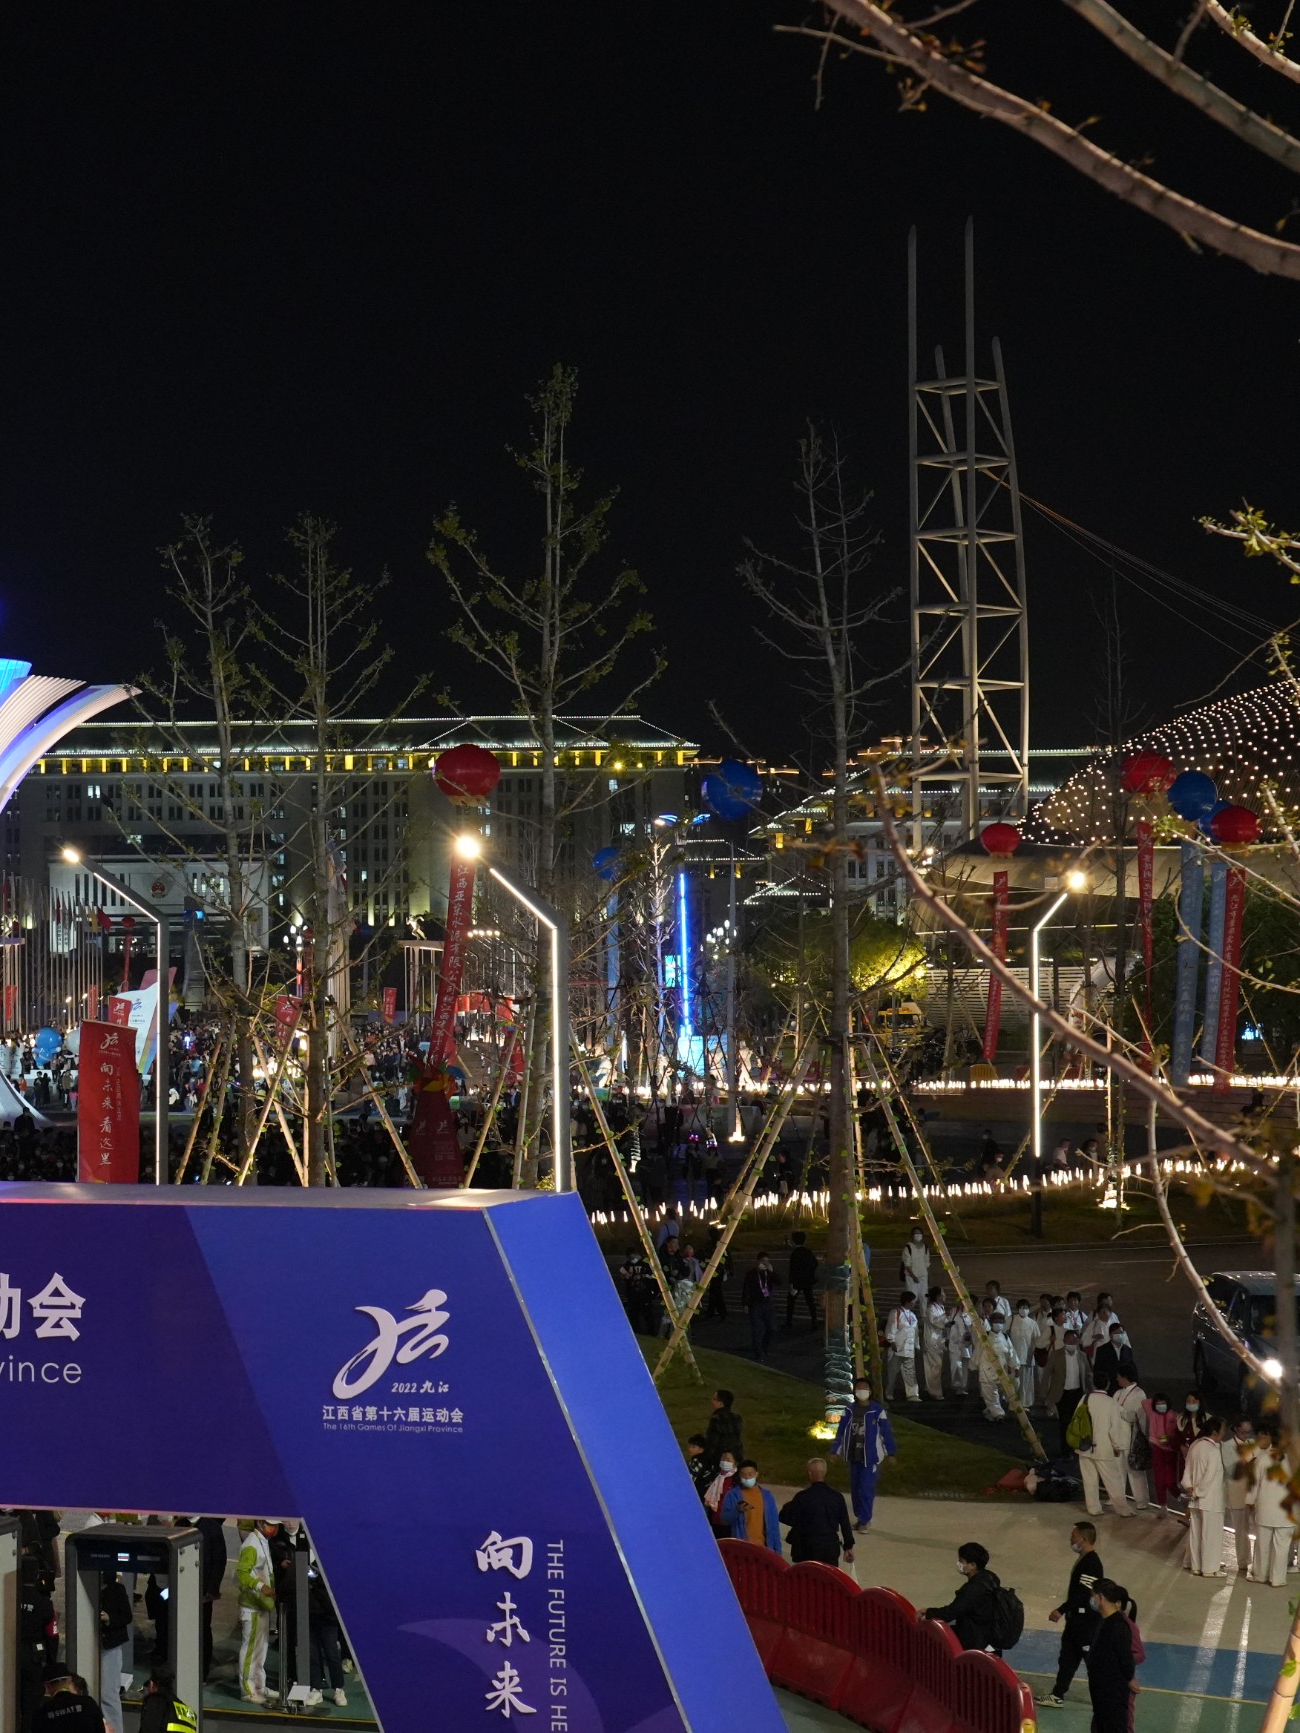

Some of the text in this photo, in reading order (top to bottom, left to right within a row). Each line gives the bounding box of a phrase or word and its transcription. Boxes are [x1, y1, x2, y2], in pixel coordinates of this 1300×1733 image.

[391, 1380, 449, 1394] 2022 九江
[322, 1405, 464, 1424] 江西省第十六届运动会
[357, 1423, 386, 1431] Games
[399, 1425, 427, 1434] Jiangxi
[428, 1425, 464, 1433] Province
[547, 1539, 564, 1580] THE
[475, 1530, 538, 1719] 向未来
[548, 1589, 566, 1669] FUTURE
[550, 1677, 567, 1696] IS
